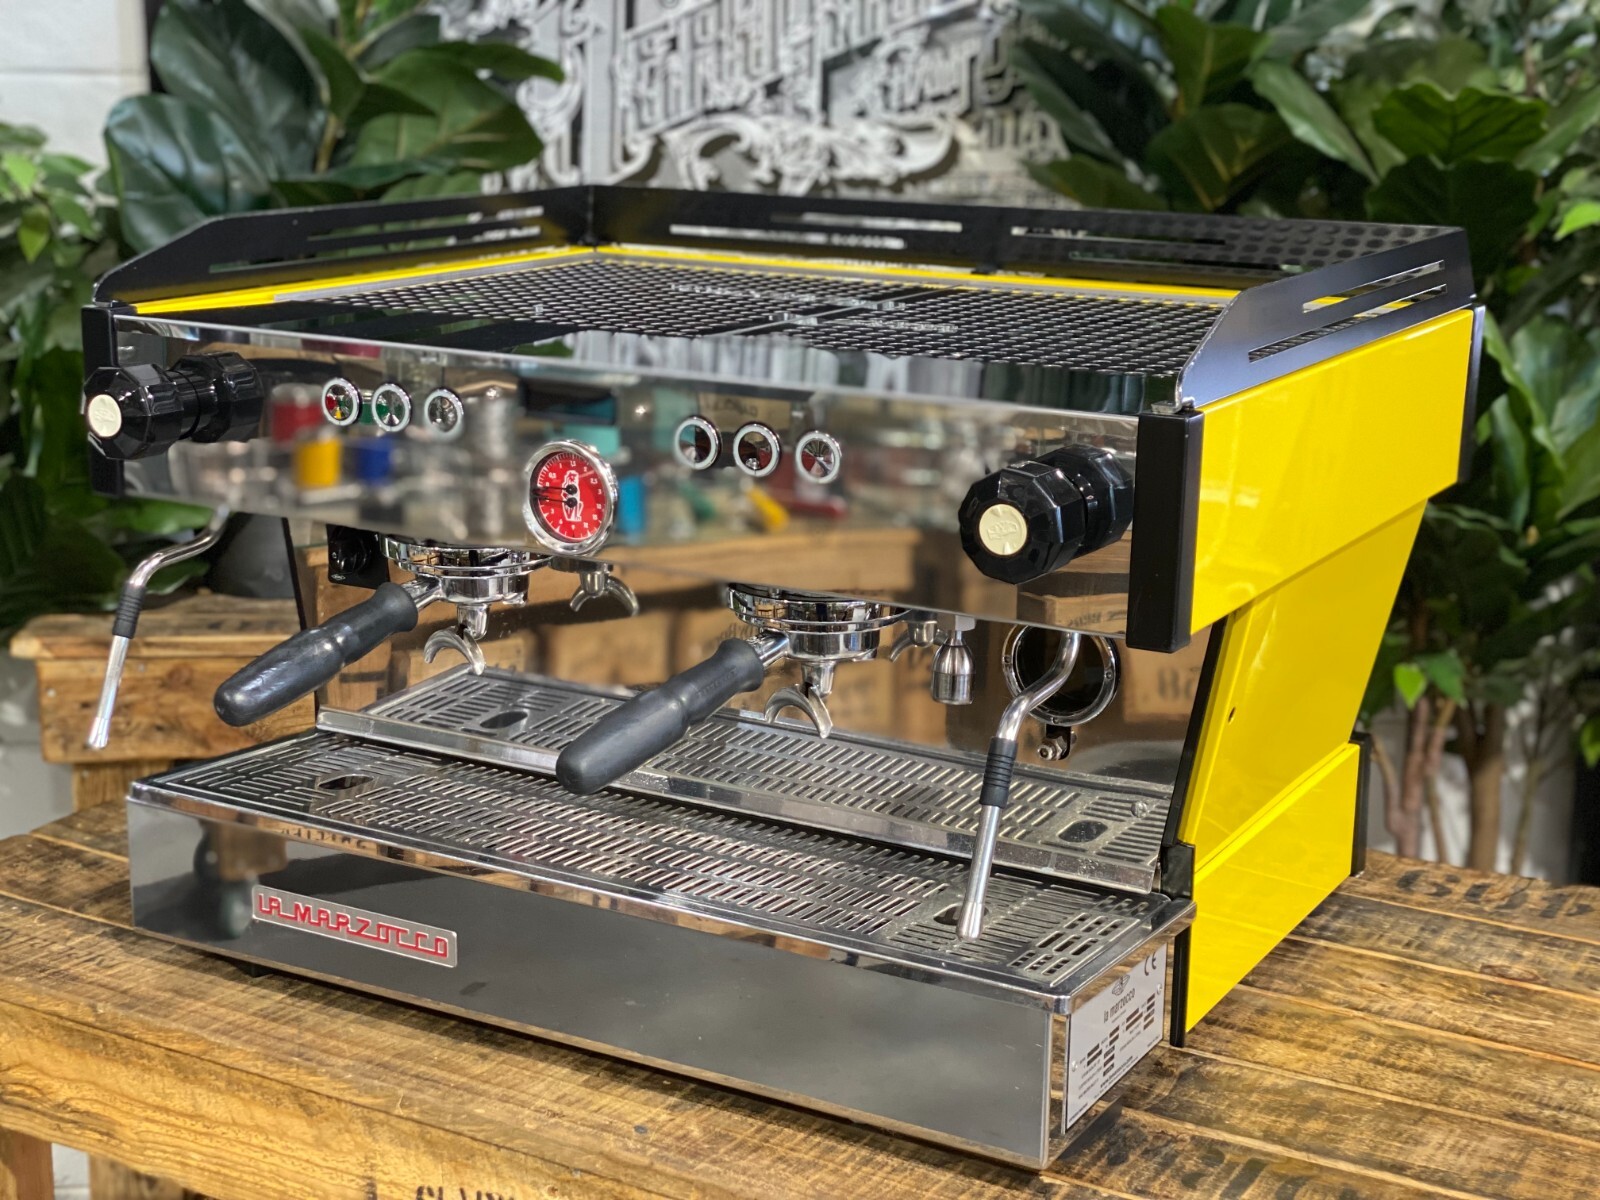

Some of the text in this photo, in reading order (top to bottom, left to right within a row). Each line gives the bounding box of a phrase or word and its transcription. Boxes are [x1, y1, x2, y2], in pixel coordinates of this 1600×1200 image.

[258, 893, 448, 957] LA MARZOCCO
[1109, 987, 1136, 1018] marzocco
